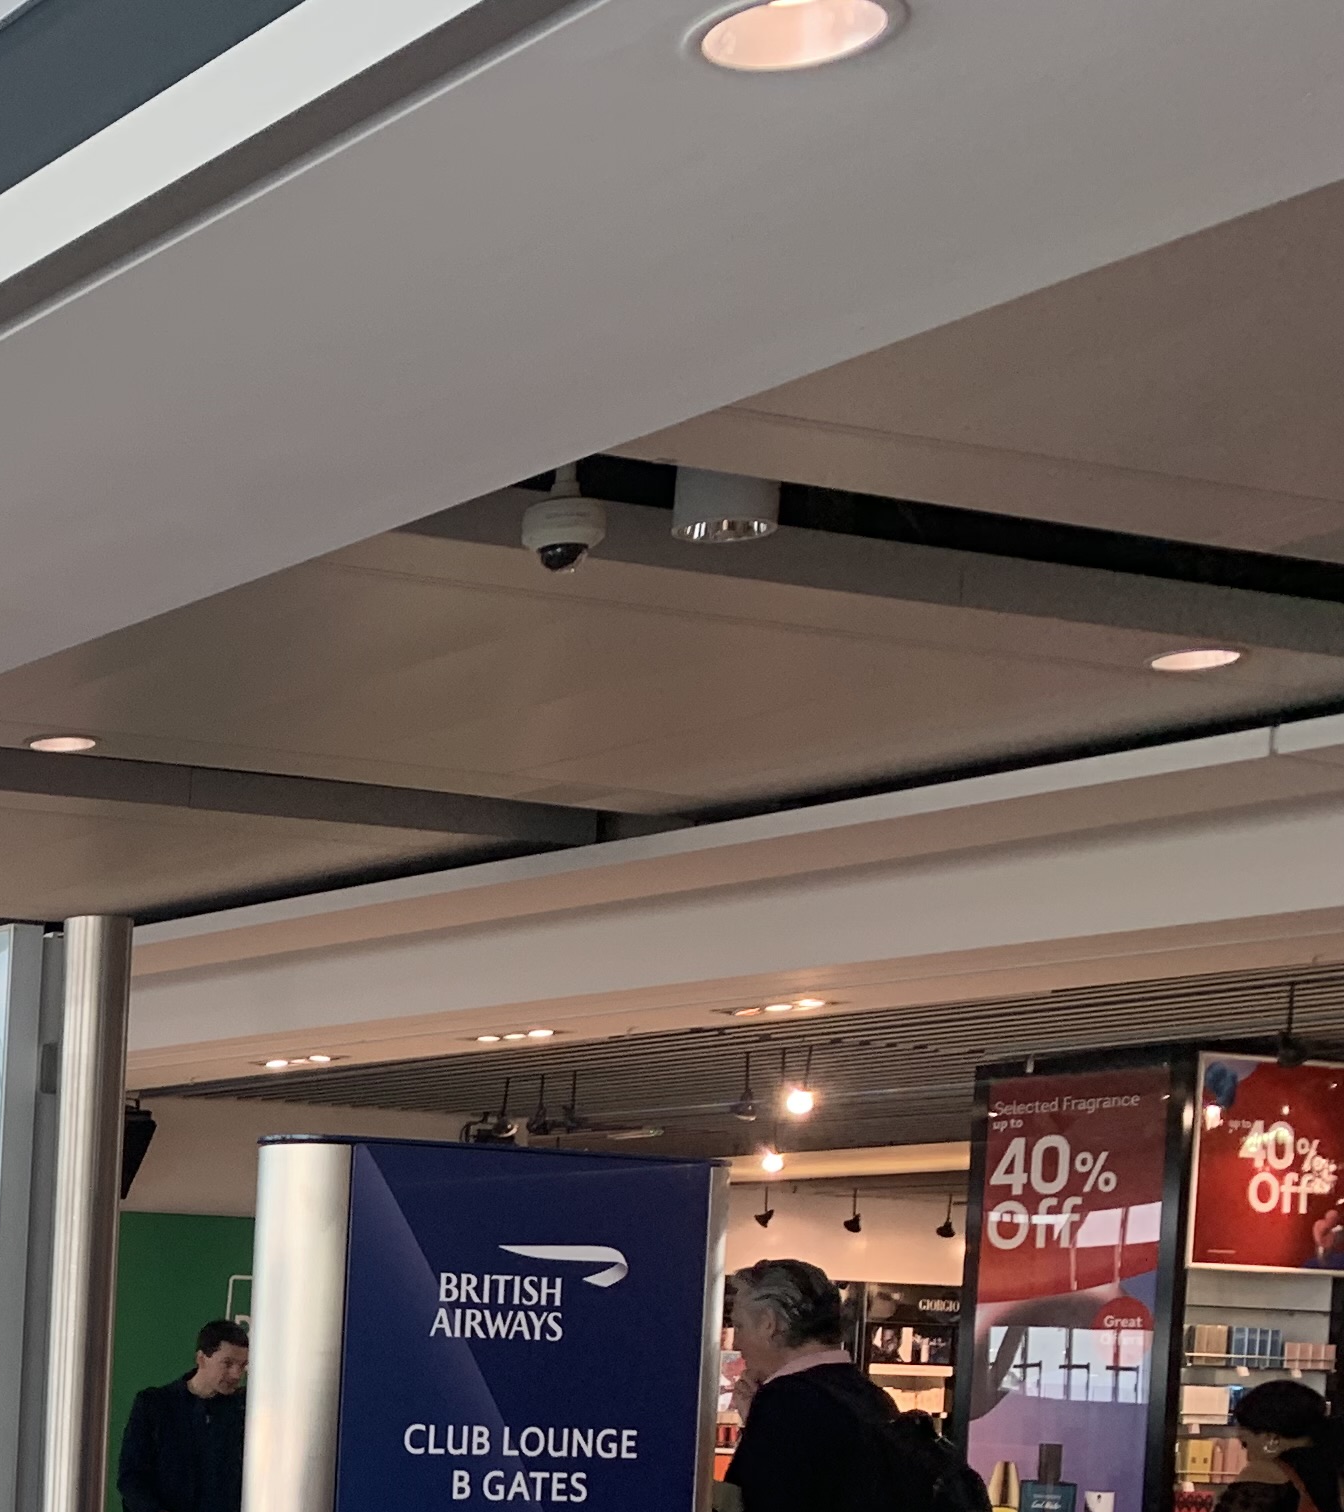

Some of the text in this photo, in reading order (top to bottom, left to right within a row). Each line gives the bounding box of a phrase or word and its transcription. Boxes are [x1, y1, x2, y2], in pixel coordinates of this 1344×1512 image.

[994, 1094, 1141, 1116] Selected Fragrance
[993, 1118, 1024, 1132] up to
[1238, 1119, 1327, 1172] 40%
[989, 1134, 1118, 1196] 40%
[1248, 1171, 1314, 1215] Off
[987, 1196, 1083, 1250] Off
[439, 1272, 563, 1307] BRITISH
[918, 1298, 961, 1313] GIORGIO
[429, 1307, 563, 1342] AIRWAYS
[1103, 1314, 1143, 1328] Great
[404, 1423, 638, 1459] CLUB LOUNGE
[452, 1469, 588, 1503] B GATES
